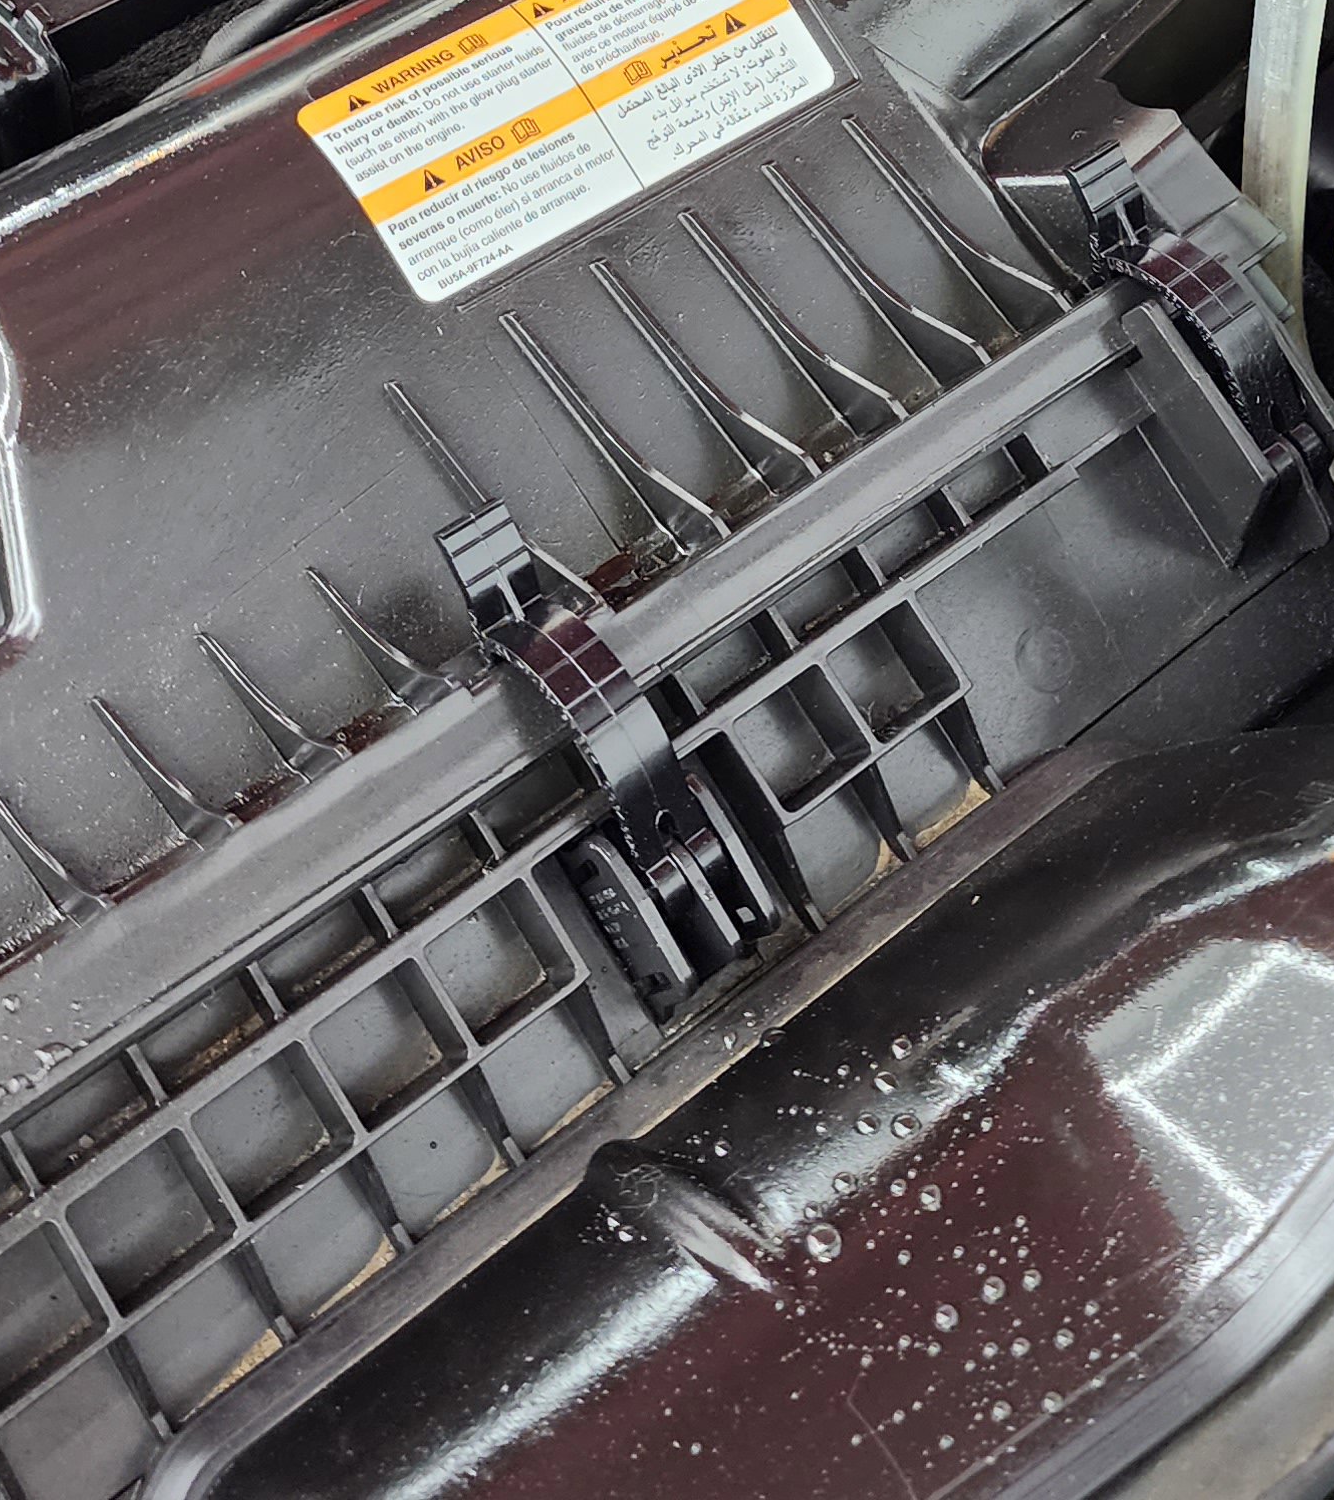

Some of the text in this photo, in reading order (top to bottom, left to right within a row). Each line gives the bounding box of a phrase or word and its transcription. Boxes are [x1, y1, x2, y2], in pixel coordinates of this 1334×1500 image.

[544, 12, 574, 31] Pour
[554, 18, 593, 43] graves
[592, 9, 609, 22] ou
[608, 2, 625, 14] de
[561, 30, 599, 52] fluides
[597, 22, 613, 34] de
[571, 45, 598, 64] avec
[597, 38, 612, 50] ce
[611, 19, 649, 43] moteur
[648, 1, 683, 25] équipé
[322, 45, 514, 143] To reduce risk of possible serious
[370, 49, 456, 94] WARNING
[371, 125, 385, 138] or
[385, 106, 424, 130] death:
[421, 97, 442, 111] Do
[440, 86, 462, 103] not
[459, 77, 482, 93] use
[480, 59, 516, 82] starter
[514, 45, 545, 65] fluids
[579, 62, 596, 75] de
[344, 57, 553, 170] (such as ether) with the glow plug starter
[354, 158, 390, 183] assist
[388, 151, 406, 165] on
[403, 142, 424, 157] the
[387, 132, 576, 236] Para reducir el riesgo de lesiones
[454, 135, 506, 172] AVISO
[398, 142, 592, 251] severas o muerte: No use fluidos de
[407, 234, 458, 267] arranque
[457, 214, 494, 241] (como
[520, 191, 533, 206] si
[531, 172, 574, 200] arranca
[573, 163, 586, 177] el
[584, 148, 616, 172] motor
[416, 264, 440, 282] con
[437, 257, 453, 270] la
[480, 218, 524, 247] caliente
[523, 210, 539, 224] de
